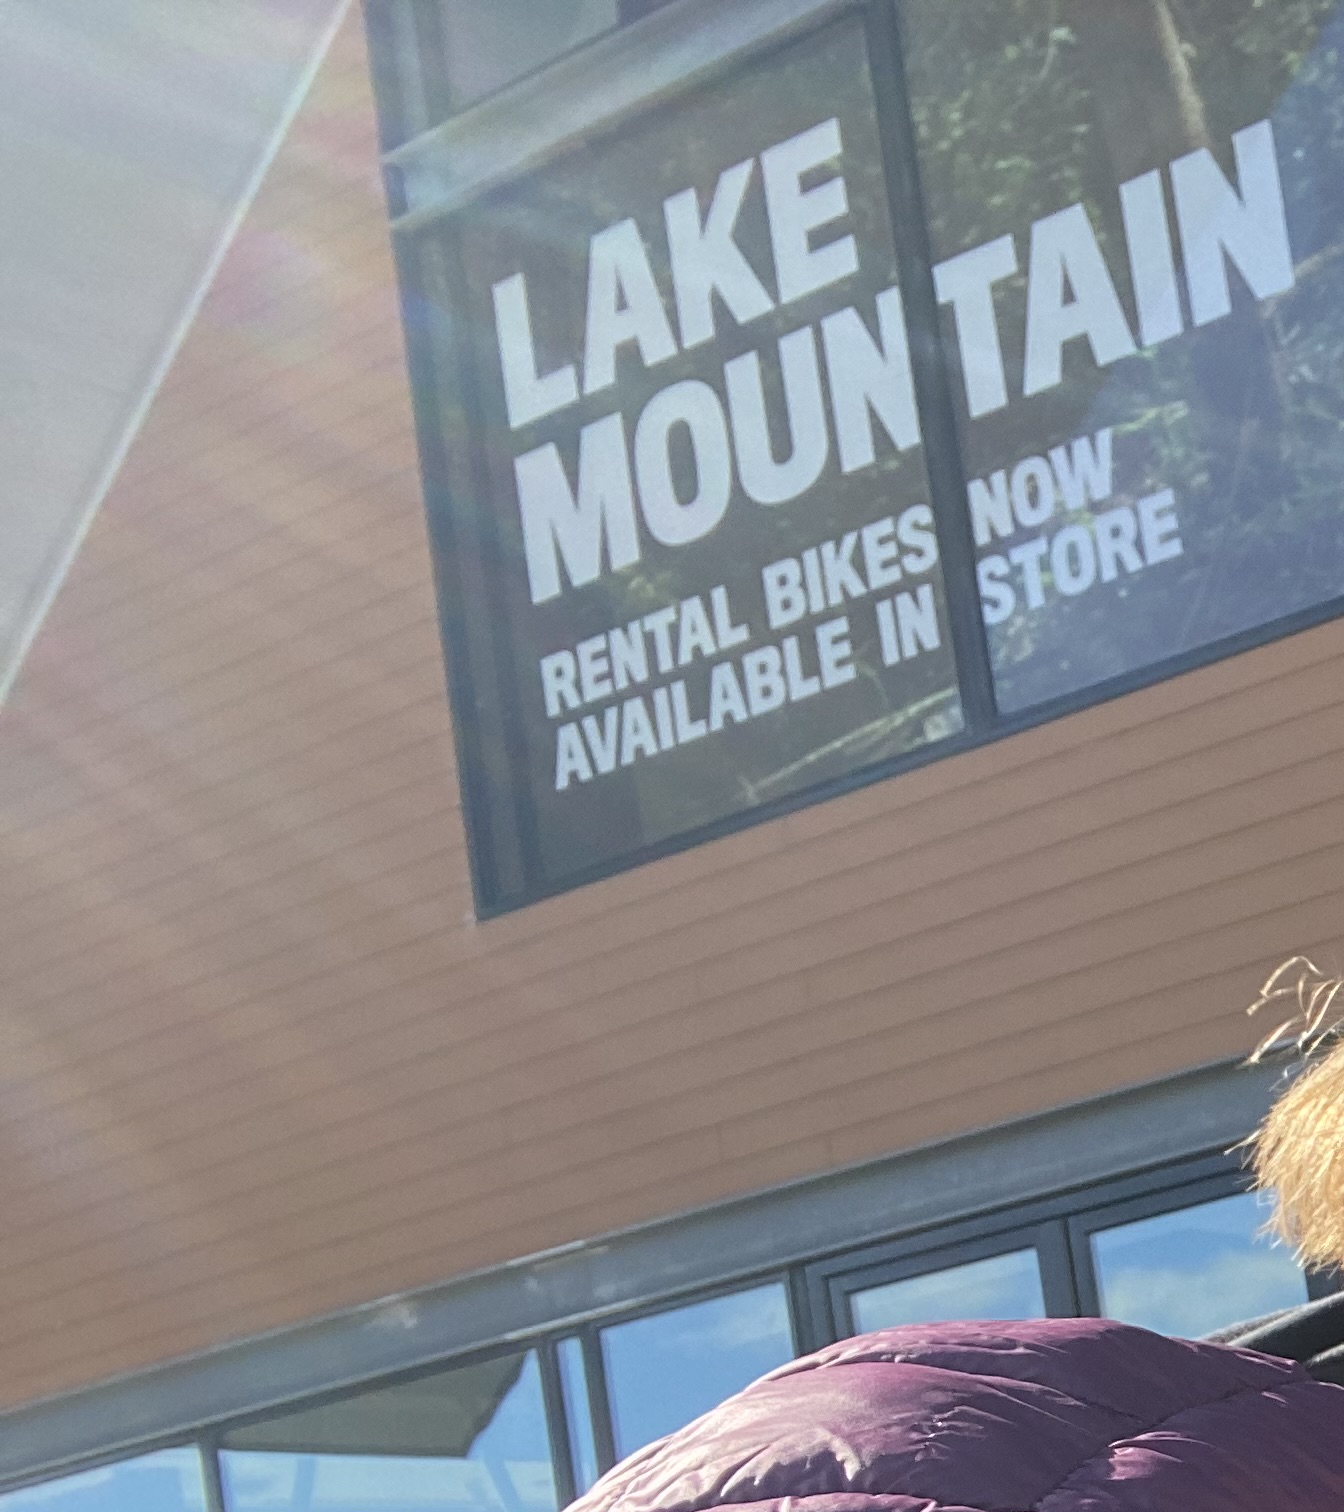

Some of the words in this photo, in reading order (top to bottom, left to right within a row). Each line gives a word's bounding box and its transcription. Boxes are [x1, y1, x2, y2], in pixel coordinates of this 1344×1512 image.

[492, 117, 859, 428] LAKE
[540, 586, 749, 718] RENTAL
[762, 504, 938, 630] BIKES
[967, 428, 1113, 544] NOW
[555, 616, 856, 790] AVAILABLE
[876, 583, 939, 667] IN
[976, 488, 1184, 625] STORE
